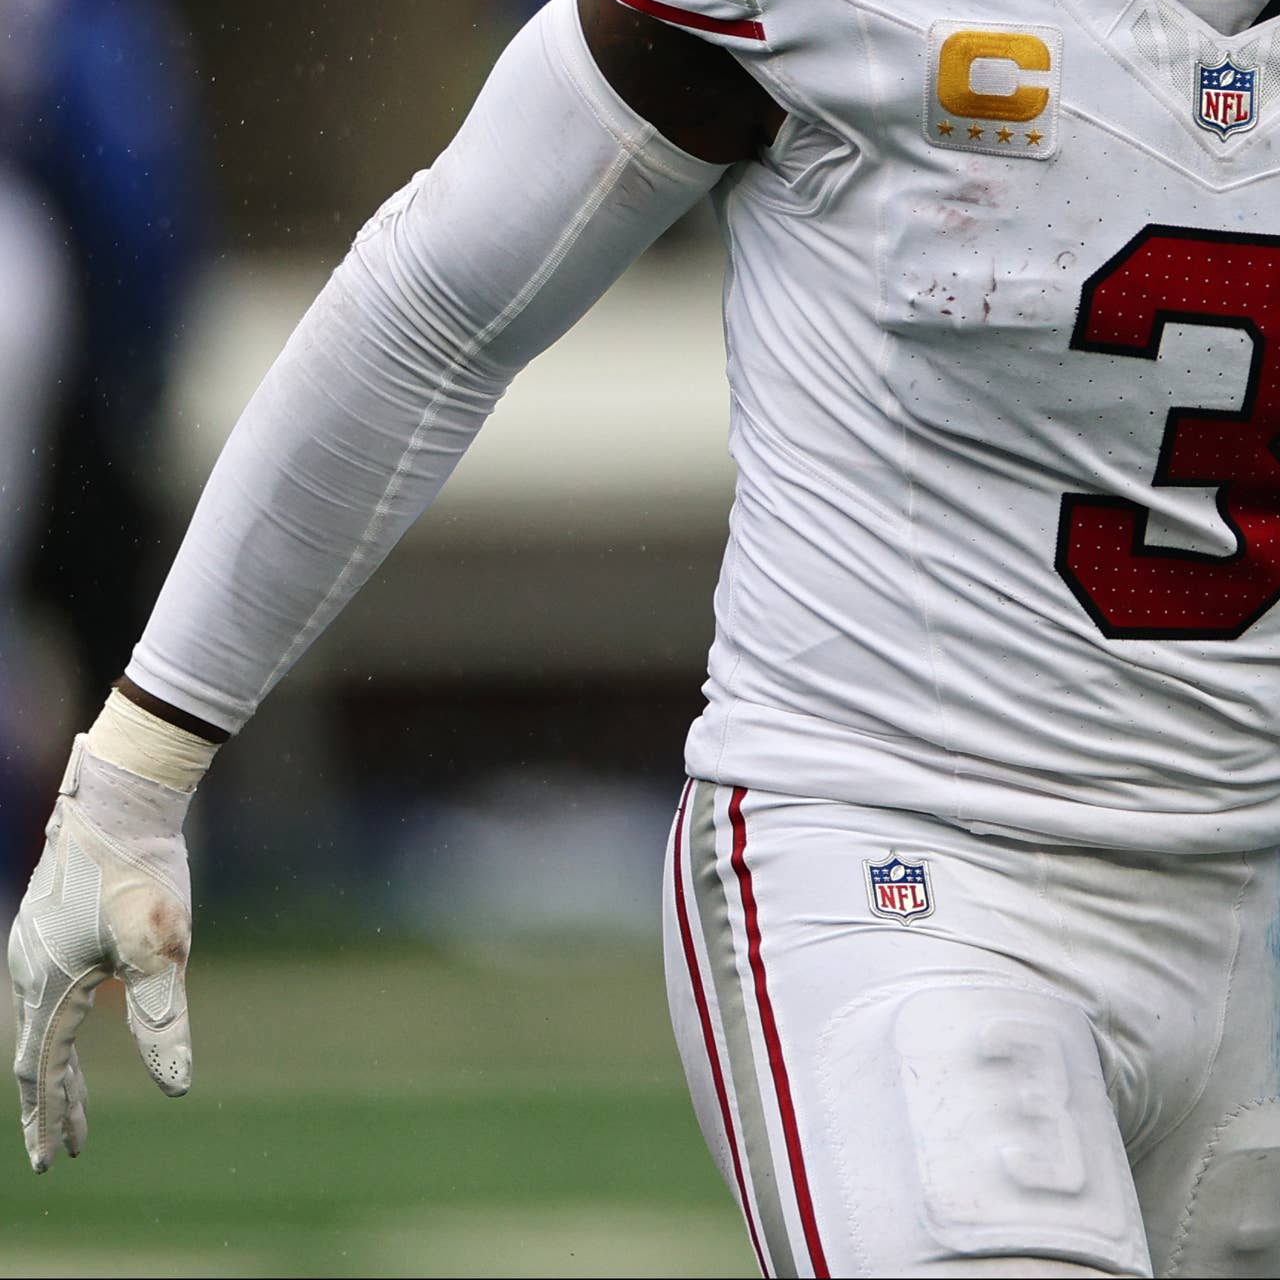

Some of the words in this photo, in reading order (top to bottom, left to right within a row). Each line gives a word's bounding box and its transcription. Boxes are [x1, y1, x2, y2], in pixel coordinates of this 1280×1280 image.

[936, 29, 1052, 123] C
[1204, 91, 1249, 125] NFL
[878, 885, 925, 912] NFL
